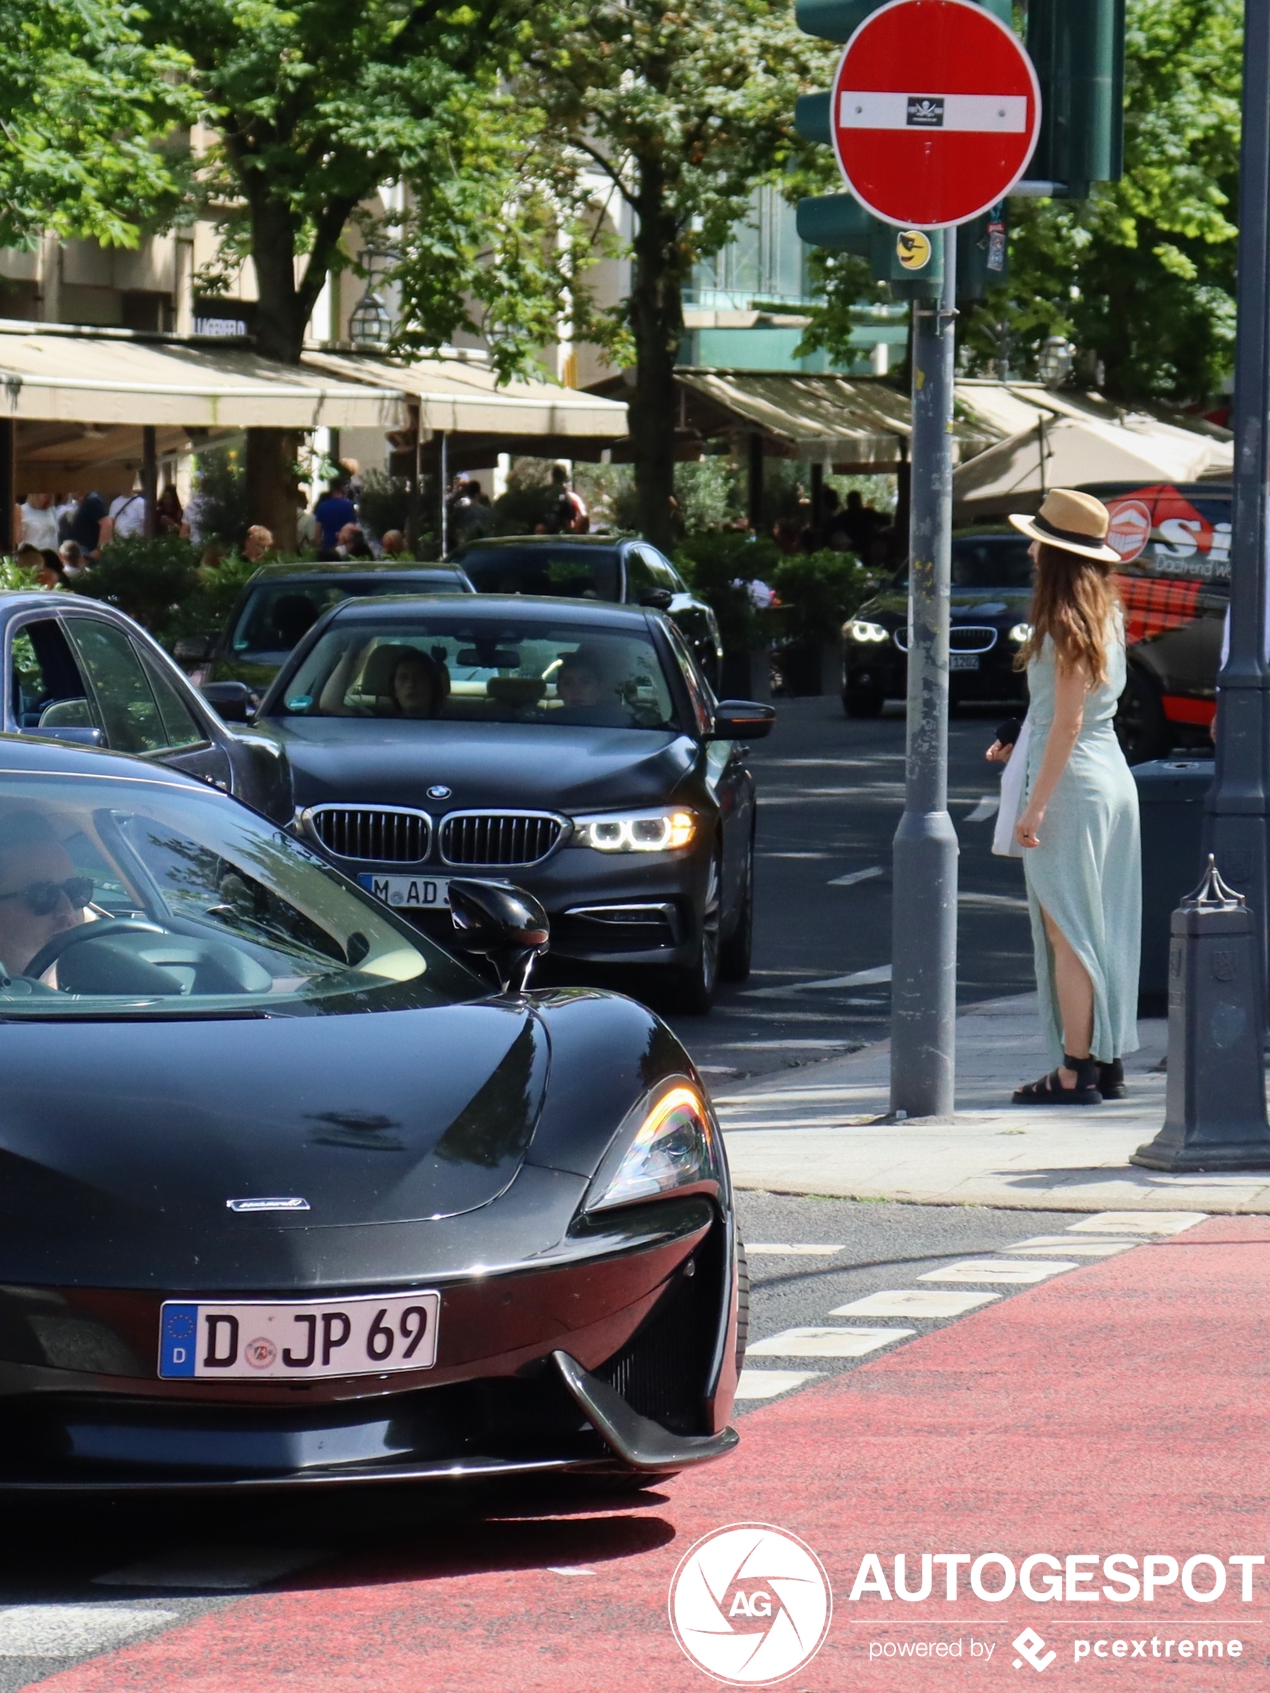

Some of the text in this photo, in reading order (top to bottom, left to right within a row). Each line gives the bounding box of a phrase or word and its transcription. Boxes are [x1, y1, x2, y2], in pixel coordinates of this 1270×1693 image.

[374, 879, 389, 902] M
[406, 881, 437, 904] AD
[203, 1314, 239, 1368] D
[282, 1312, 351, 1368] JP
[366, 1306, 427, 1361] 69
[173, 1348, 186, 1364] D
